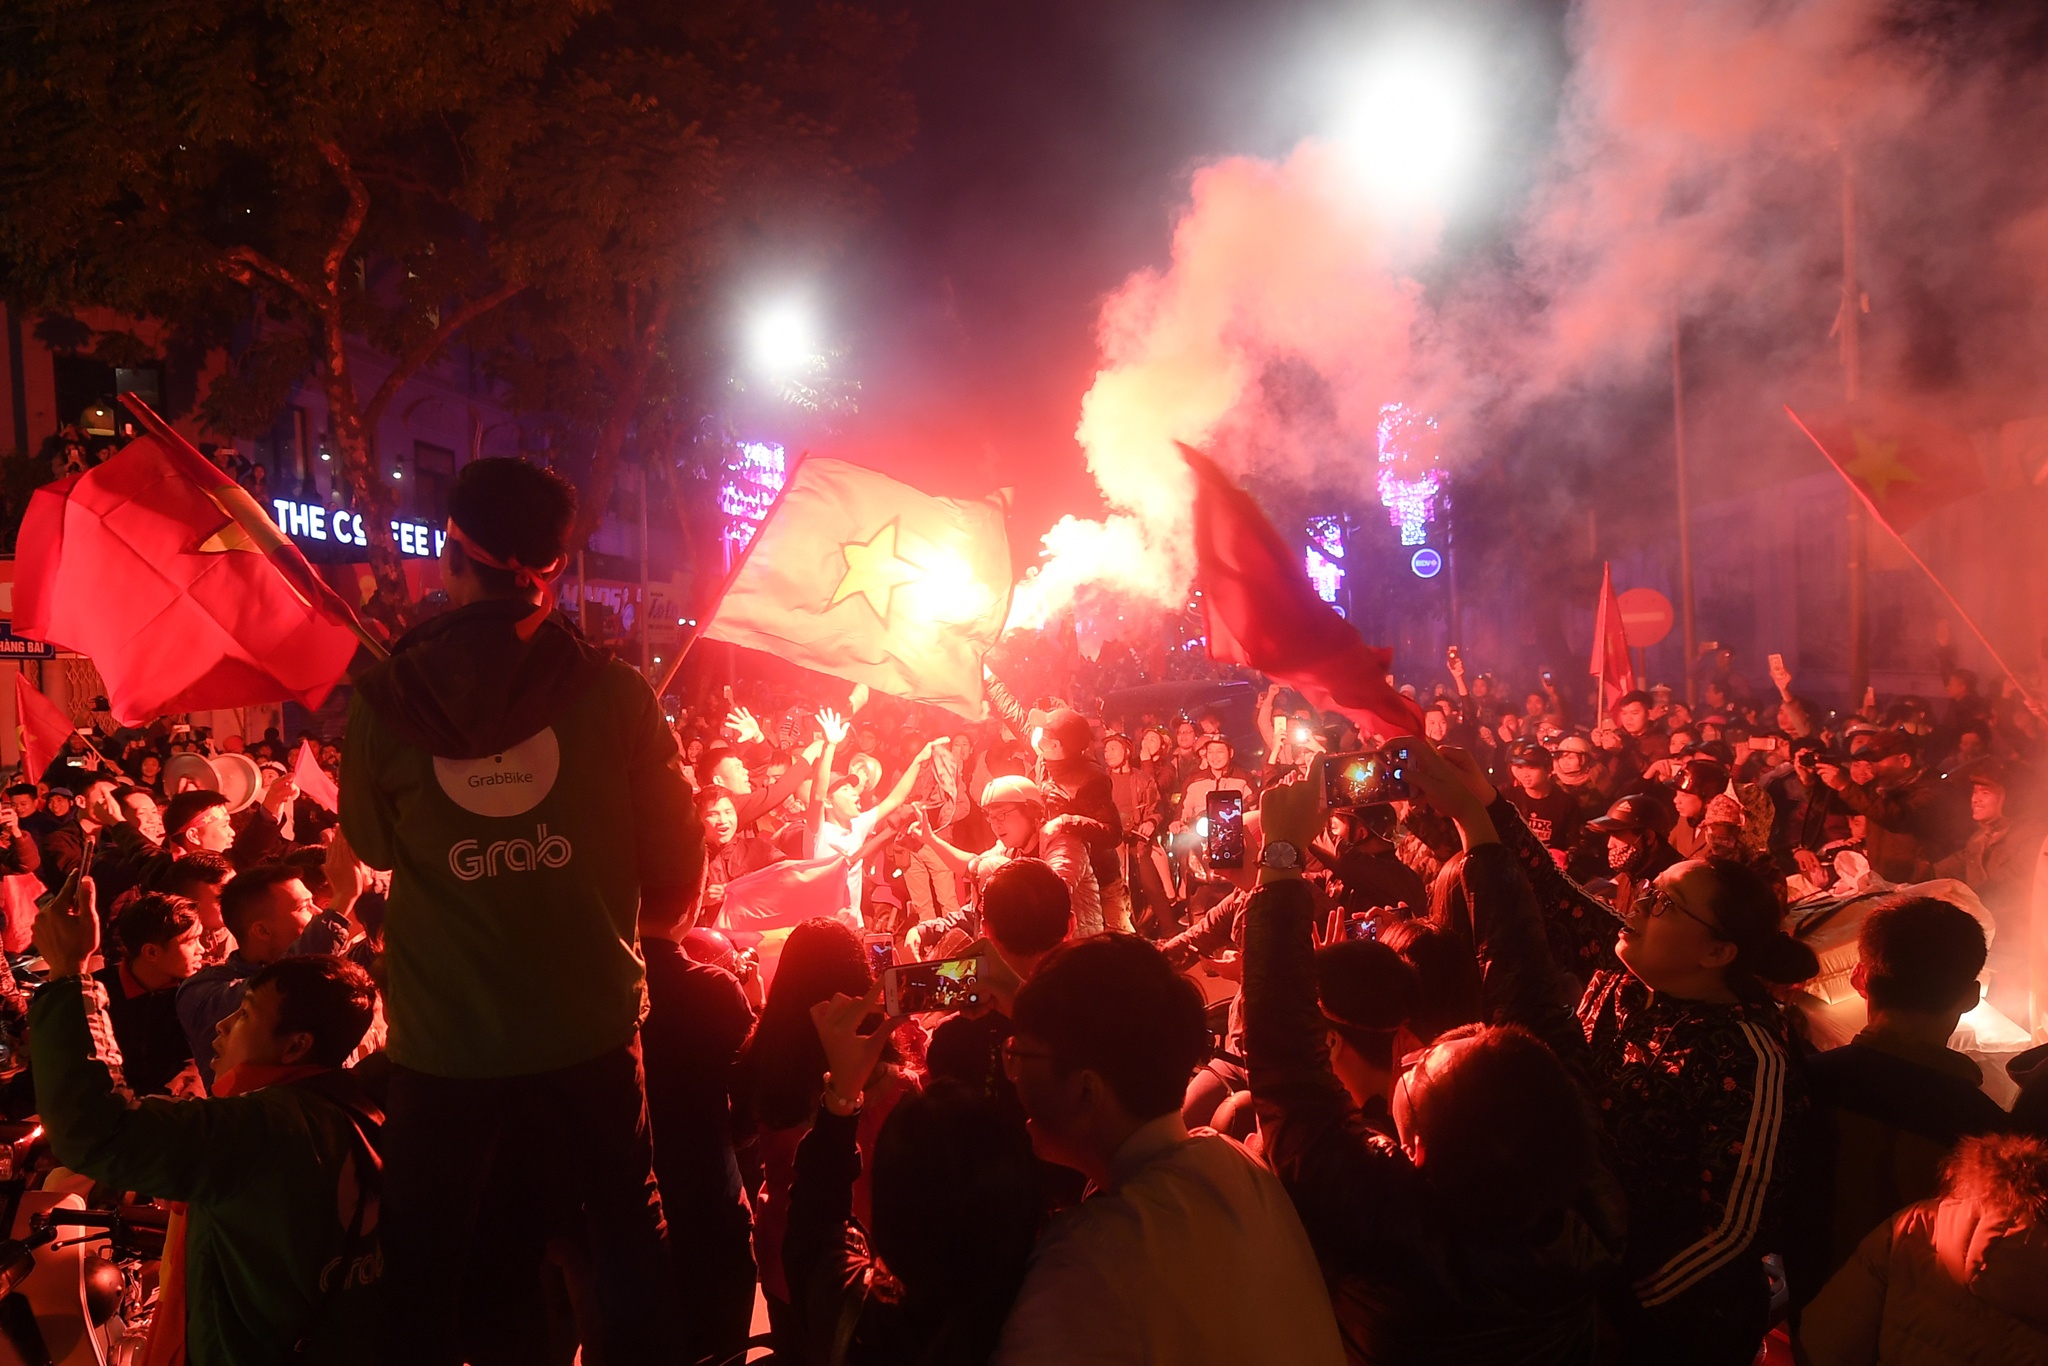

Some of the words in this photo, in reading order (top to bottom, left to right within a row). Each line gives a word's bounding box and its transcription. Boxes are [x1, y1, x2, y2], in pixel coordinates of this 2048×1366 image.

[273, 499, 327, 540] THE
[468, 772, 533, 787] GrabBike
[448, 823, 572, 881] Grab
